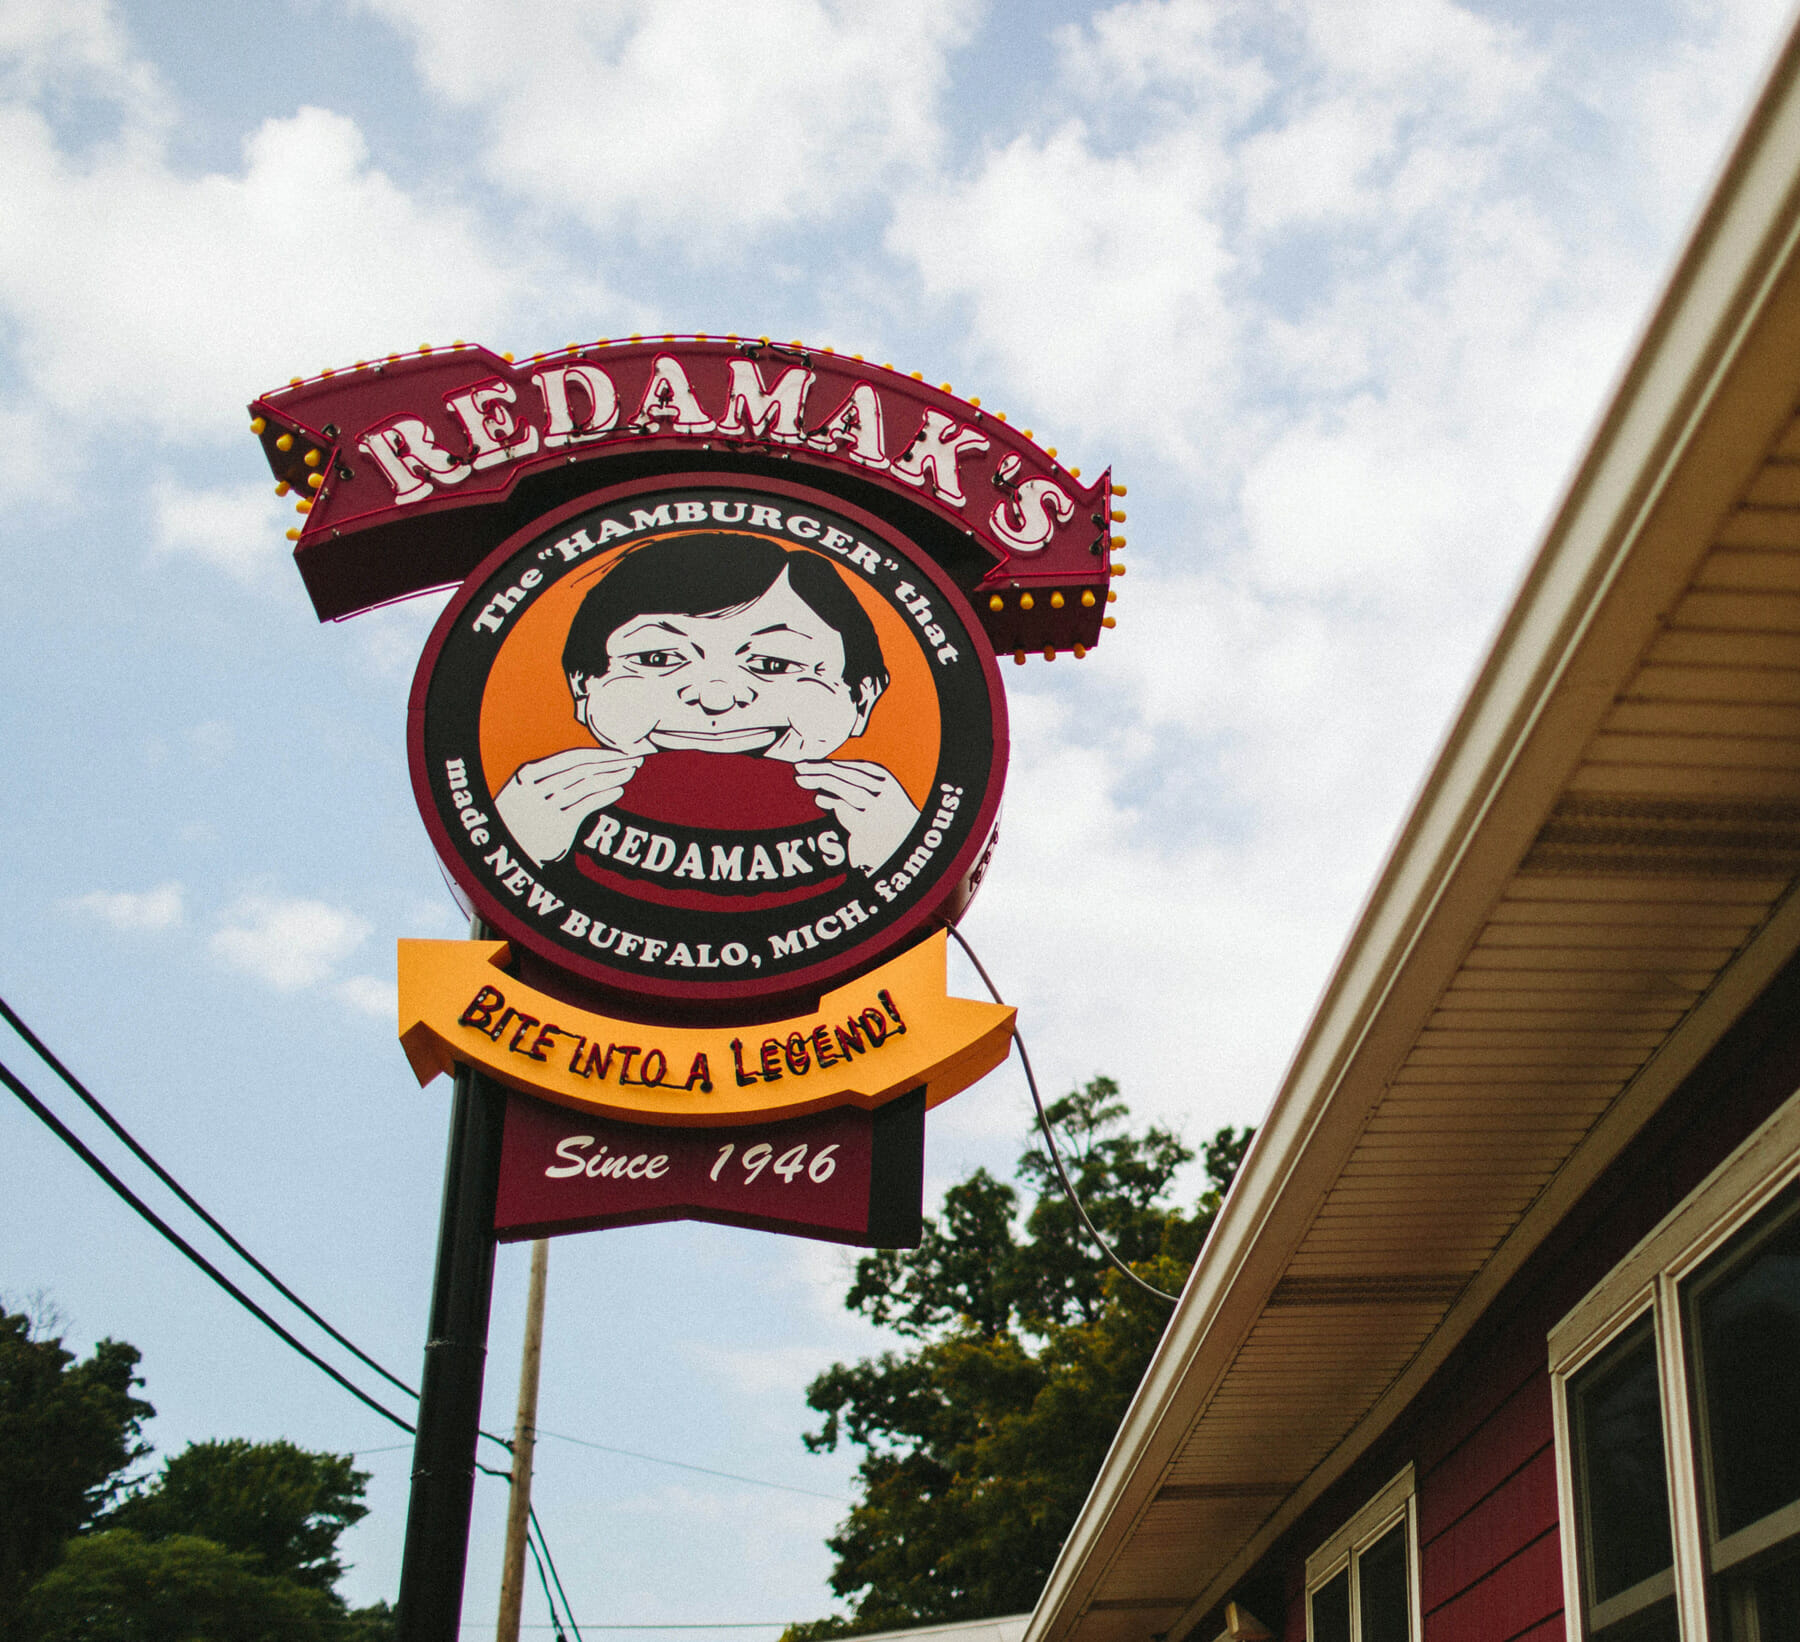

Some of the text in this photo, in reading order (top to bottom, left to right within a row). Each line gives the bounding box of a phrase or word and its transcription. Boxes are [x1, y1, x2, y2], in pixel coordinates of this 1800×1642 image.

[356, 353, 1075, 553] REDAMAK'S
[472, 567, 543, 634] The
[894, 579, 959, 666] that
[446, 757, 490, 847] made
[484, 846, 565, 917] NEW
[561, 911, 762, 969] BUFFALO,
[768, 902, 878, 960] MICH.
[874, 783, 964, 903] famous!
[584, 815, 847, 882] REDAMAK'S
[458, 985, 906, 1092] BITE INTO A LEGEND!
[545, 1136, 841, 1184] Since 1946
